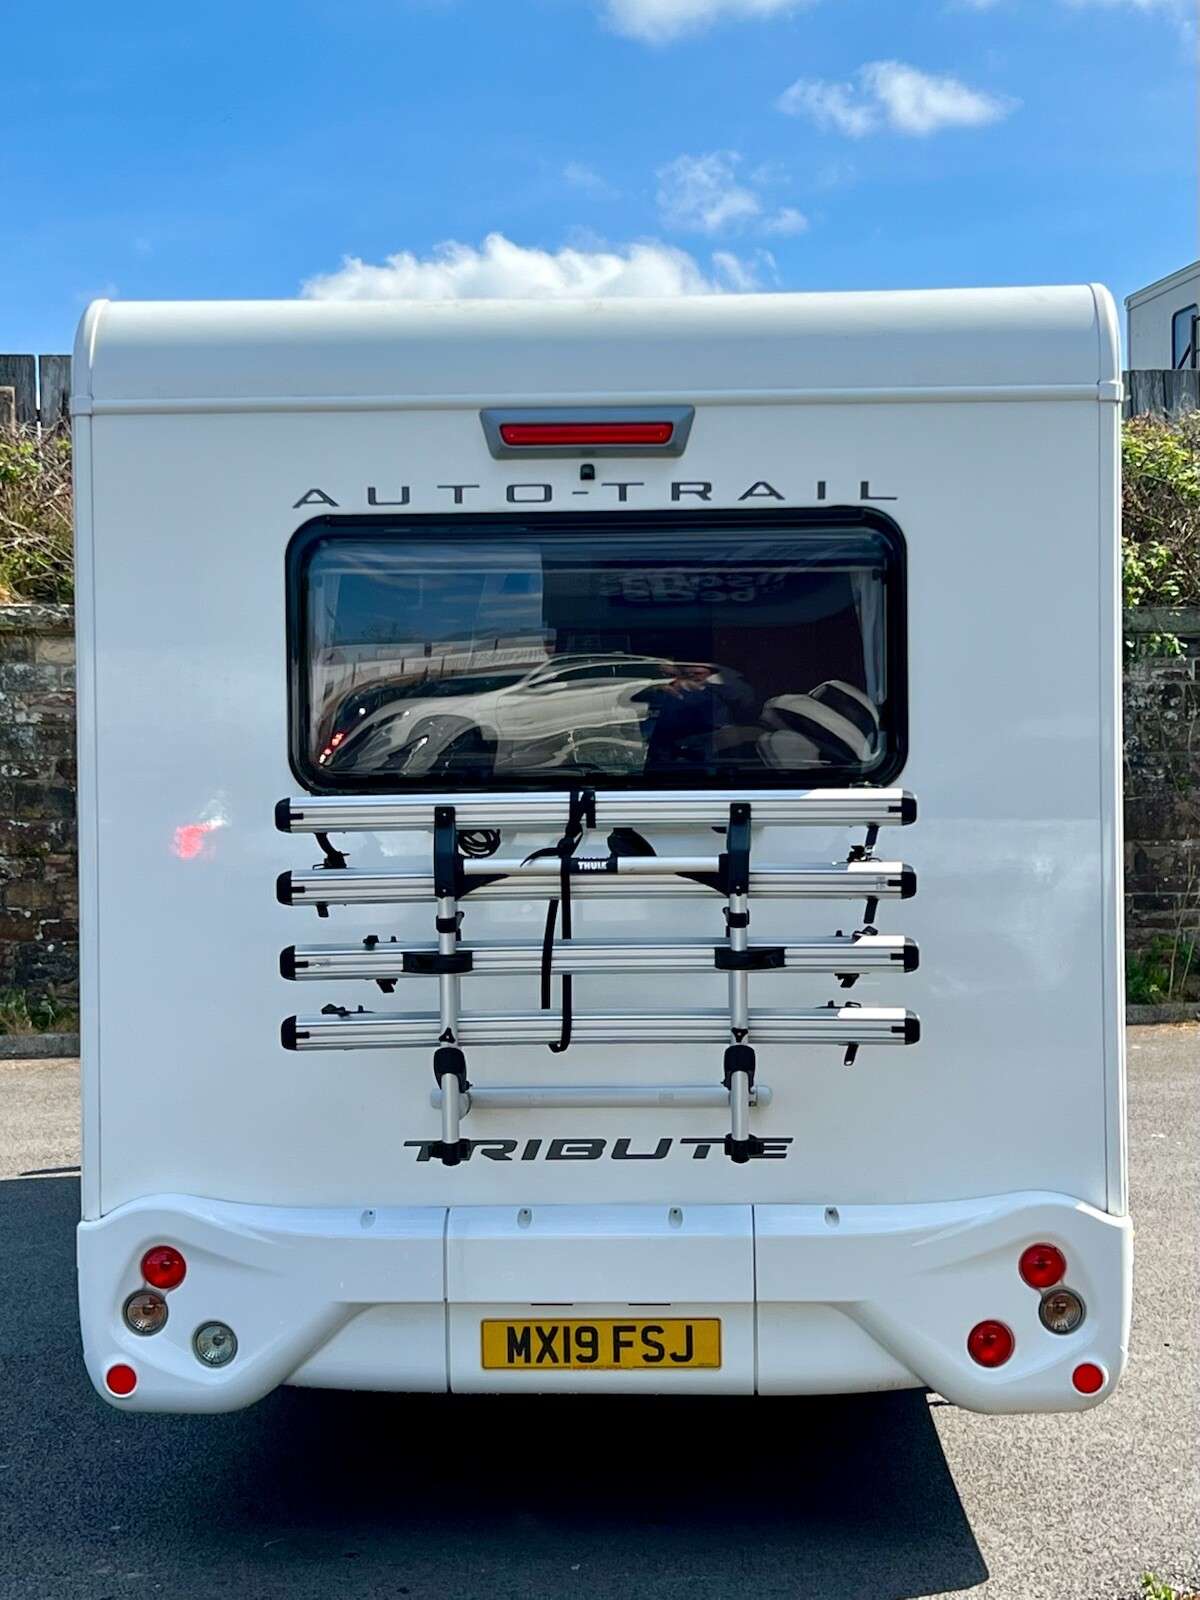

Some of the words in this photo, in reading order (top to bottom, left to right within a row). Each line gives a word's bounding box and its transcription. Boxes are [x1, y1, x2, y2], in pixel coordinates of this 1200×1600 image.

[292, 480, 899, 509] AUTO-TRAIL
[577, 861, 608, 870] THULE
[506, 1326, 599, 1364] MX19
[612, 1325, 693, 1363] FSJ
